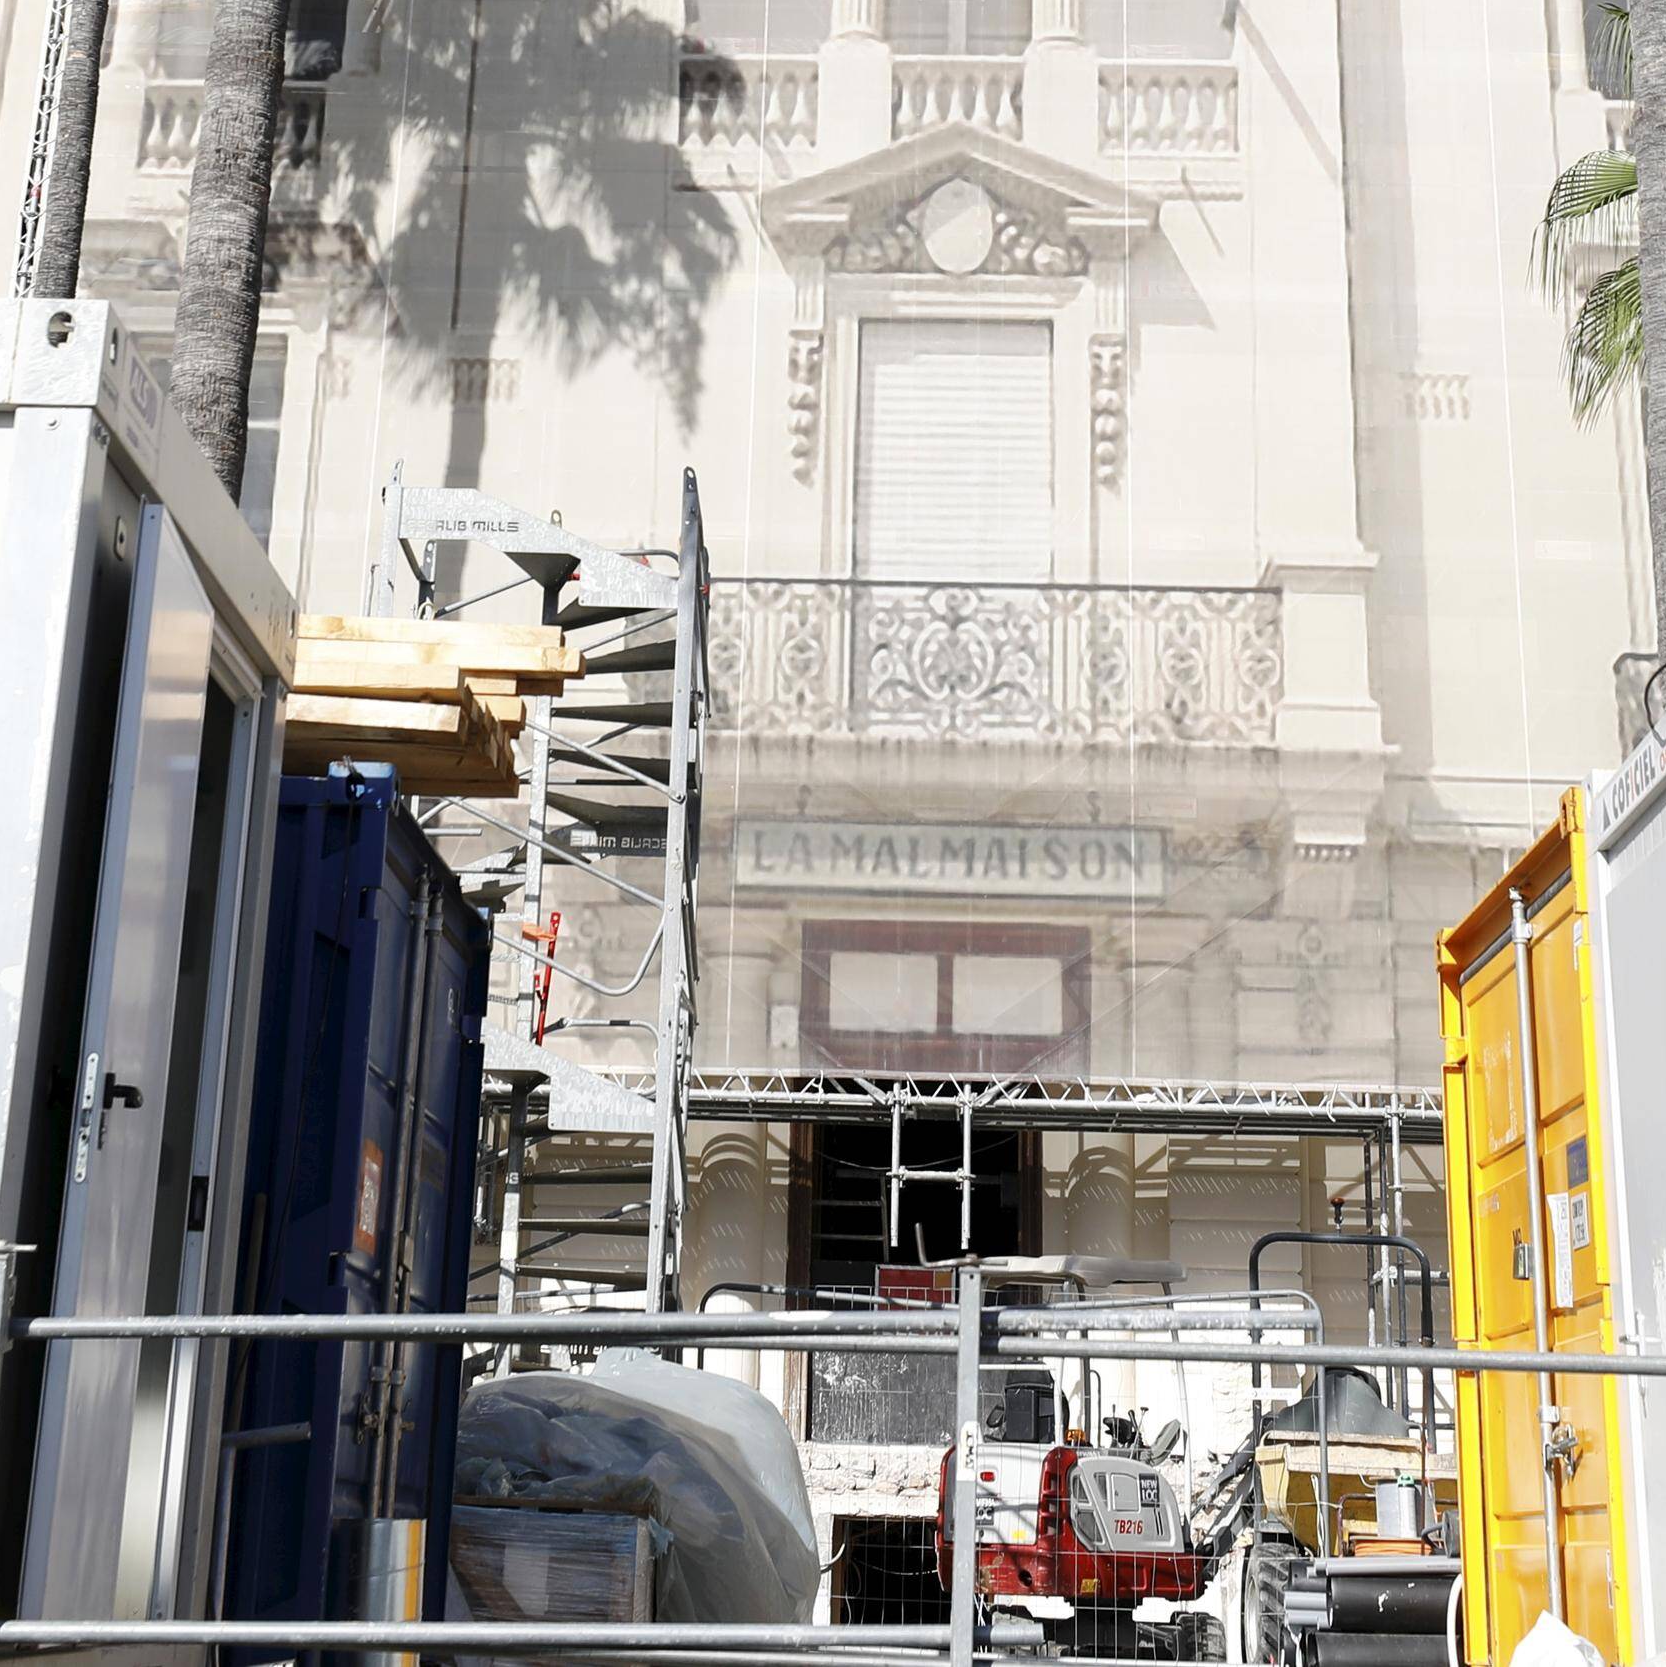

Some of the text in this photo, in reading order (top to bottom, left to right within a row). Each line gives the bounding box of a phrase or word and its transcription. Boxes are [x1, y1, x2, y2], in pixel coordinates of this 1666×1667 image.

[754, 830, 1146, 881] LA MALMAISON
[1114, 1519, 1144, 1535] TB216
